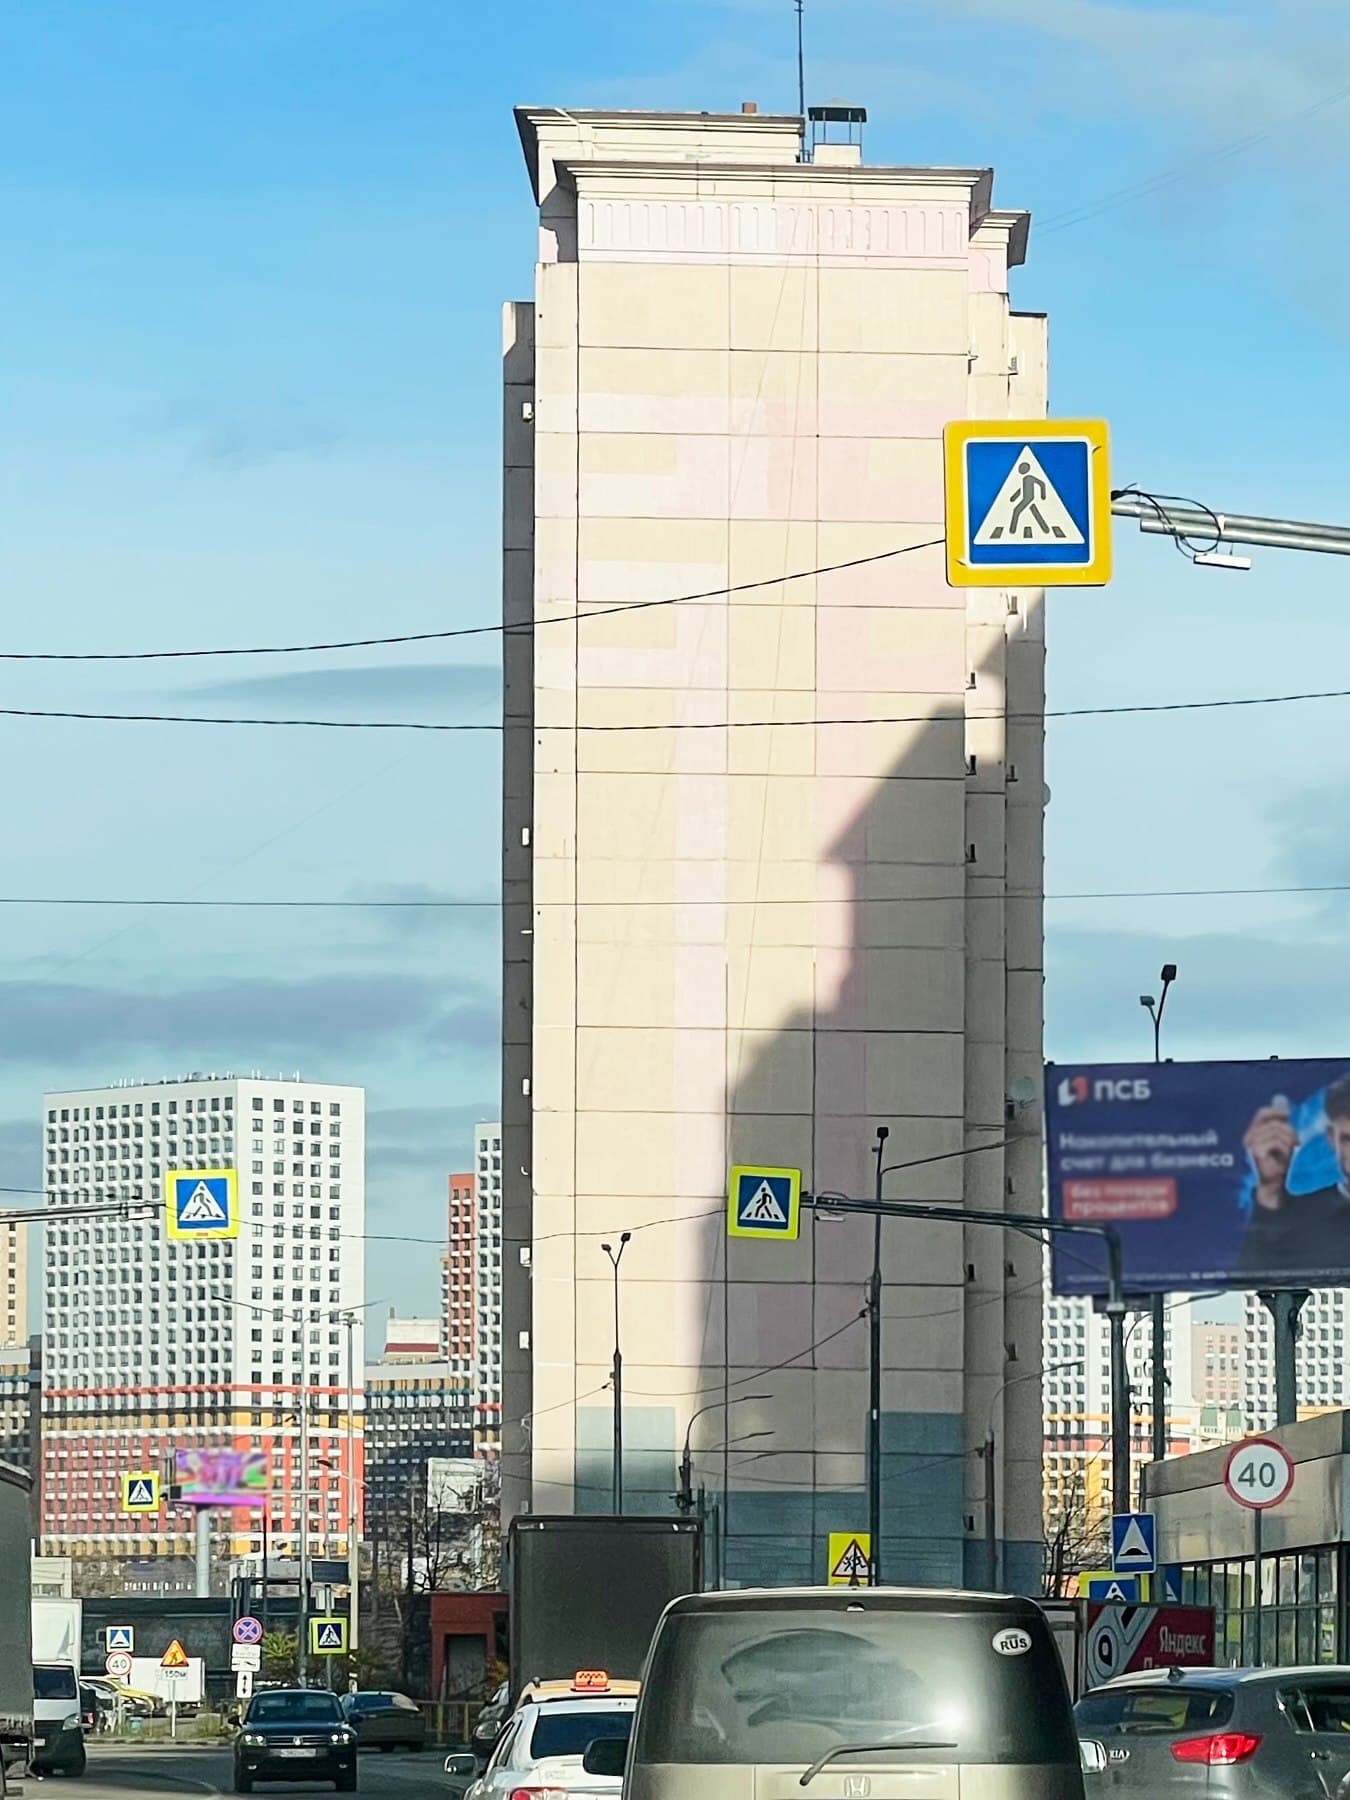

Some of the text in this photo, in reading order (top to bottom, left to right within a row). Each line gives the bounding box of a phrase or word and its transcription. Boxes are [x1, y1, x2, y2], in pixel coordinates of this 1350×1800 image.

[1094, 1079, 1151, 1101] ПСБ
[1151, 1151, 1234, 1169] бизнеса
[1237, 1461, 1276, 1488] 40
[1000, 1638, 1028, 1650] RUS
[1159, 1625, 1207, 1657] Яндекс
[112, 1659, 127, 1669] 40
